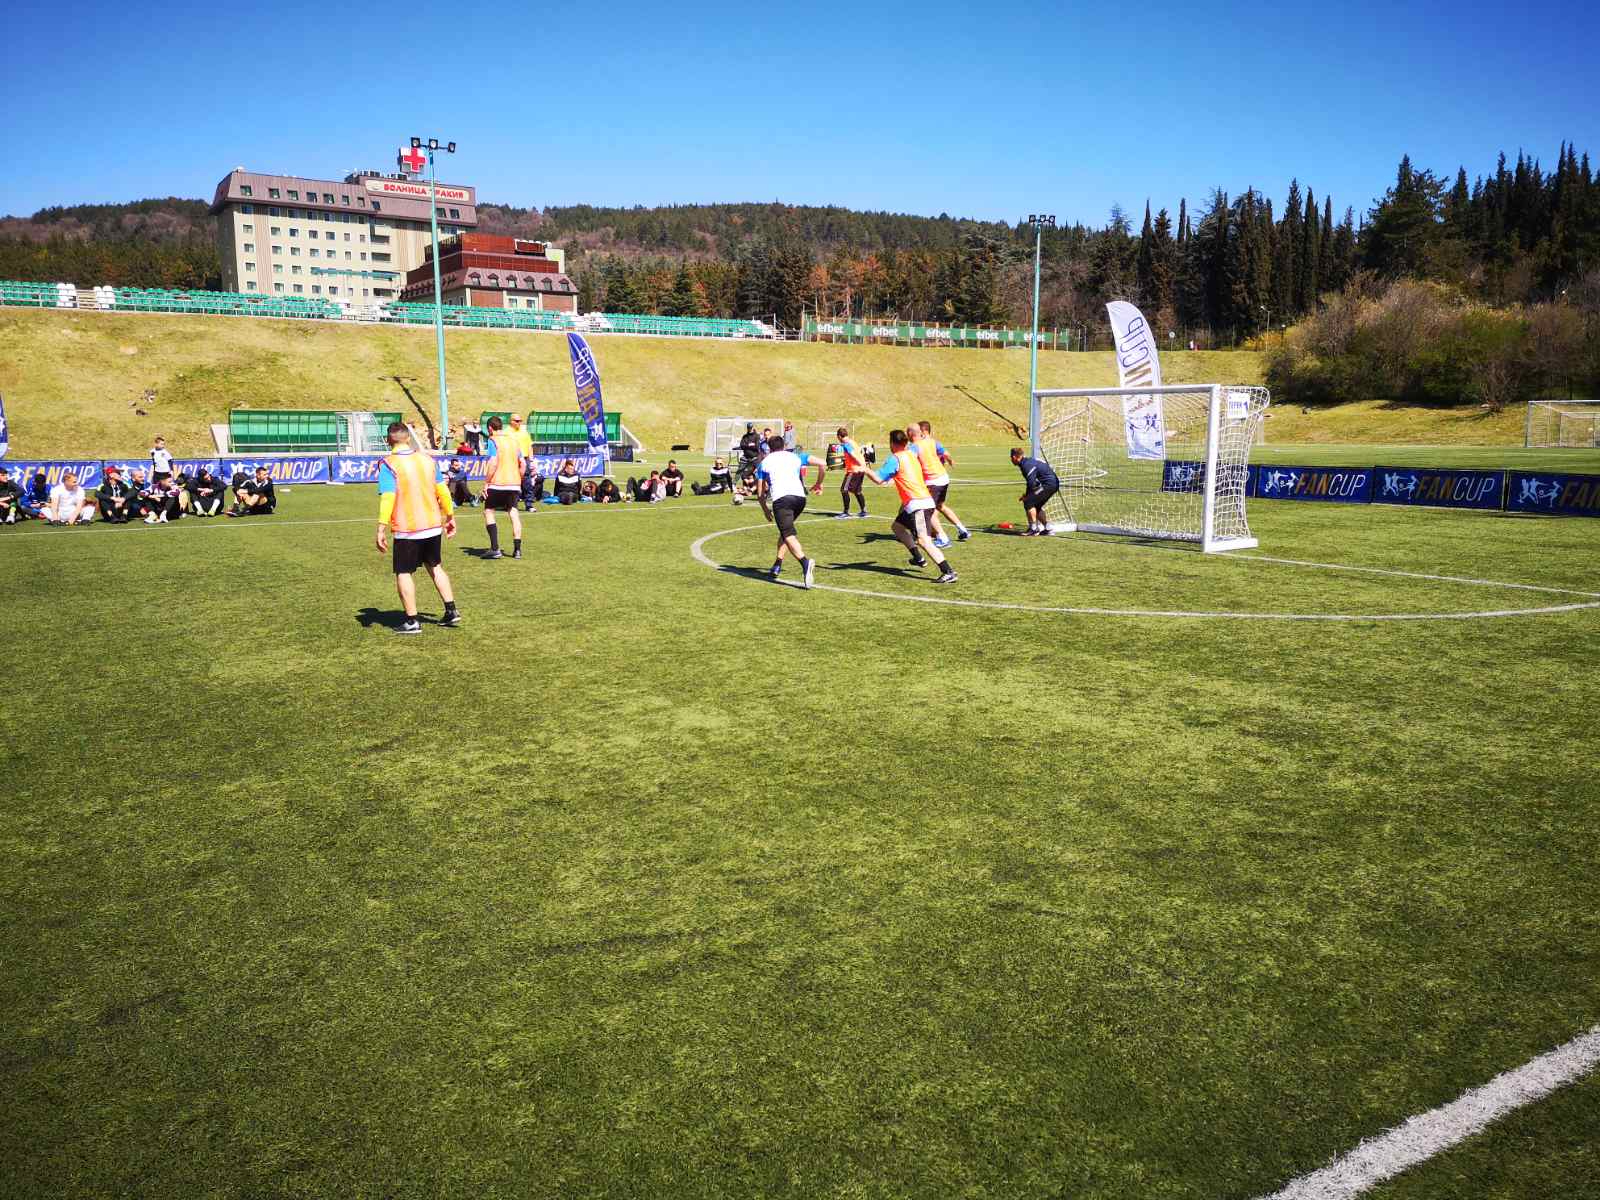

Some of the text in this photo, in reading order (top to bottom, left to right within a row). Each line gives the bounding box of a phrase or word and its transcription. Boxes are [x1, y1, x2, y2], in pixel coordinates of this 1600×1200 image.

[383, 183, 464, 199] БОЛНИЦА РАКИЯ
[873, 327, 899, 337] efbet
[926, 329, 951, 339] efbet
[975, 331, 1000, 341] efbet
[1295, 473, 1366, 496] FANCUP
[1415, 476, 1495, 501] FANCUP
